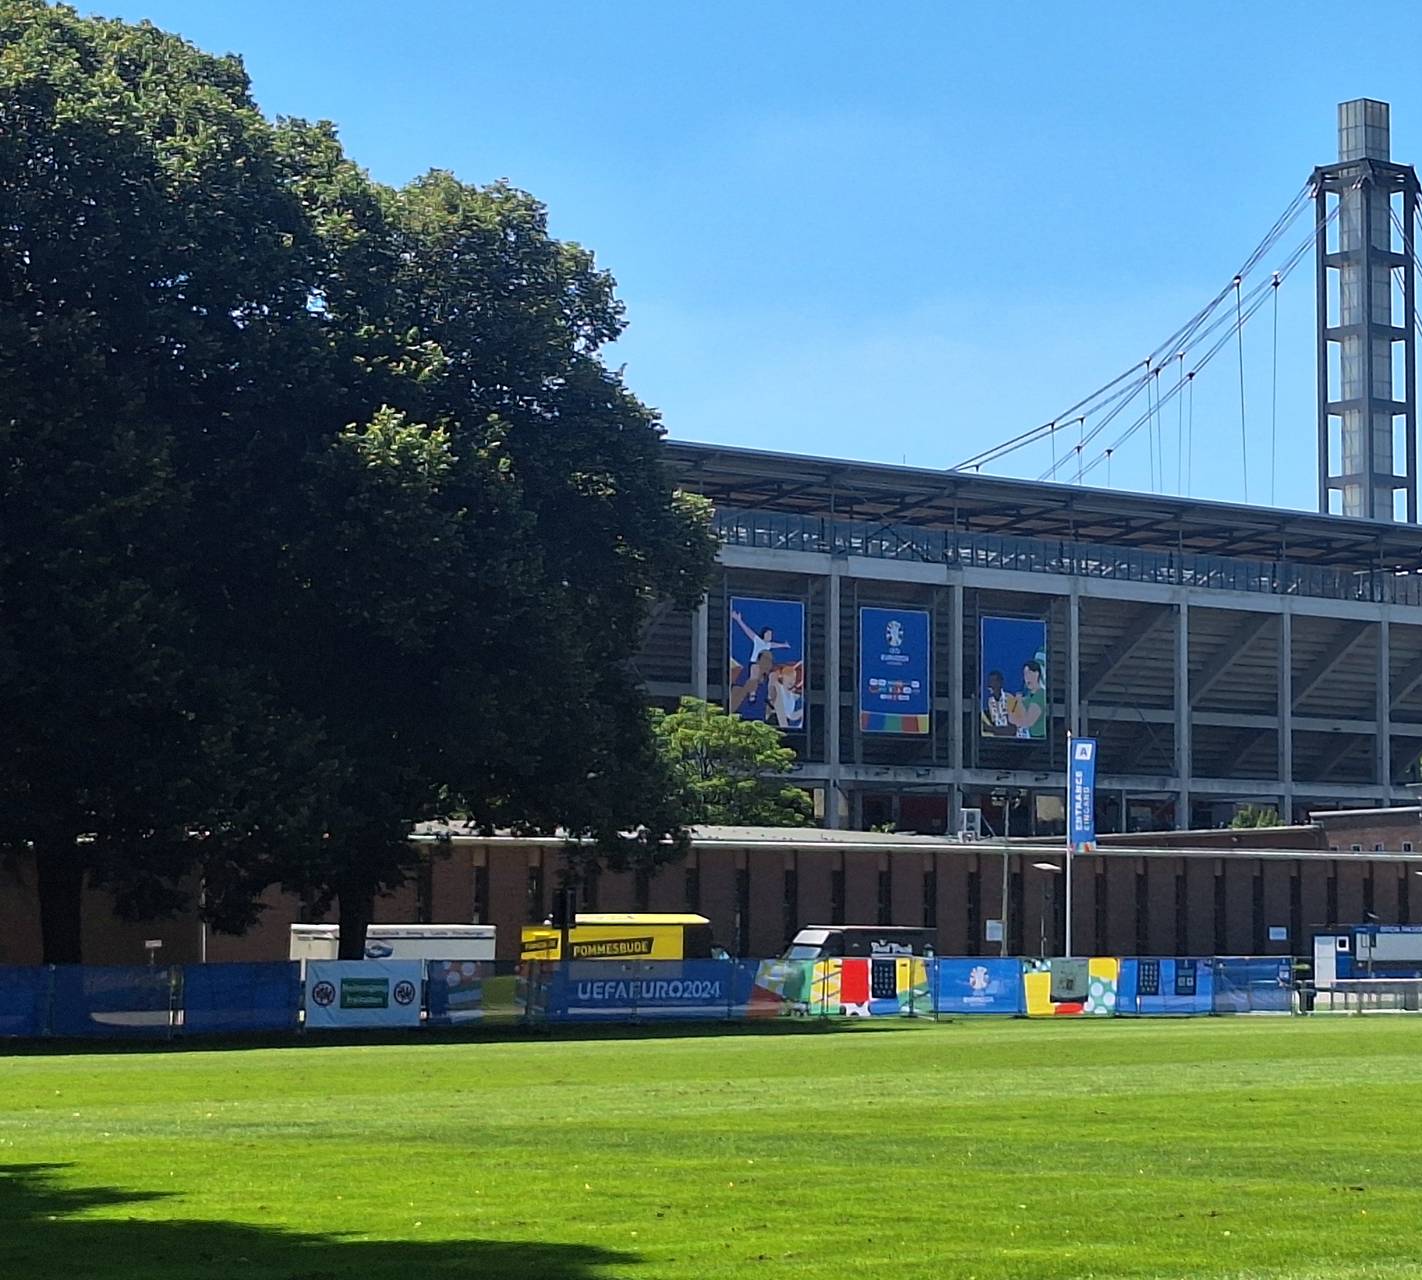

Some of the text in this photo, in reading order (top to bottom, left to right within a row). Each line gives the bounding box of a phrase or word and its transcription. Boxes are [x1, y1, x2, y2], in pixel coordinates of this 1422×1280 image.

[1080, 747, 1087, 756] A
[1075, 770, 1083, 831] ENTRANCE
[573, 940, 649, 957] POMMESBUDE
